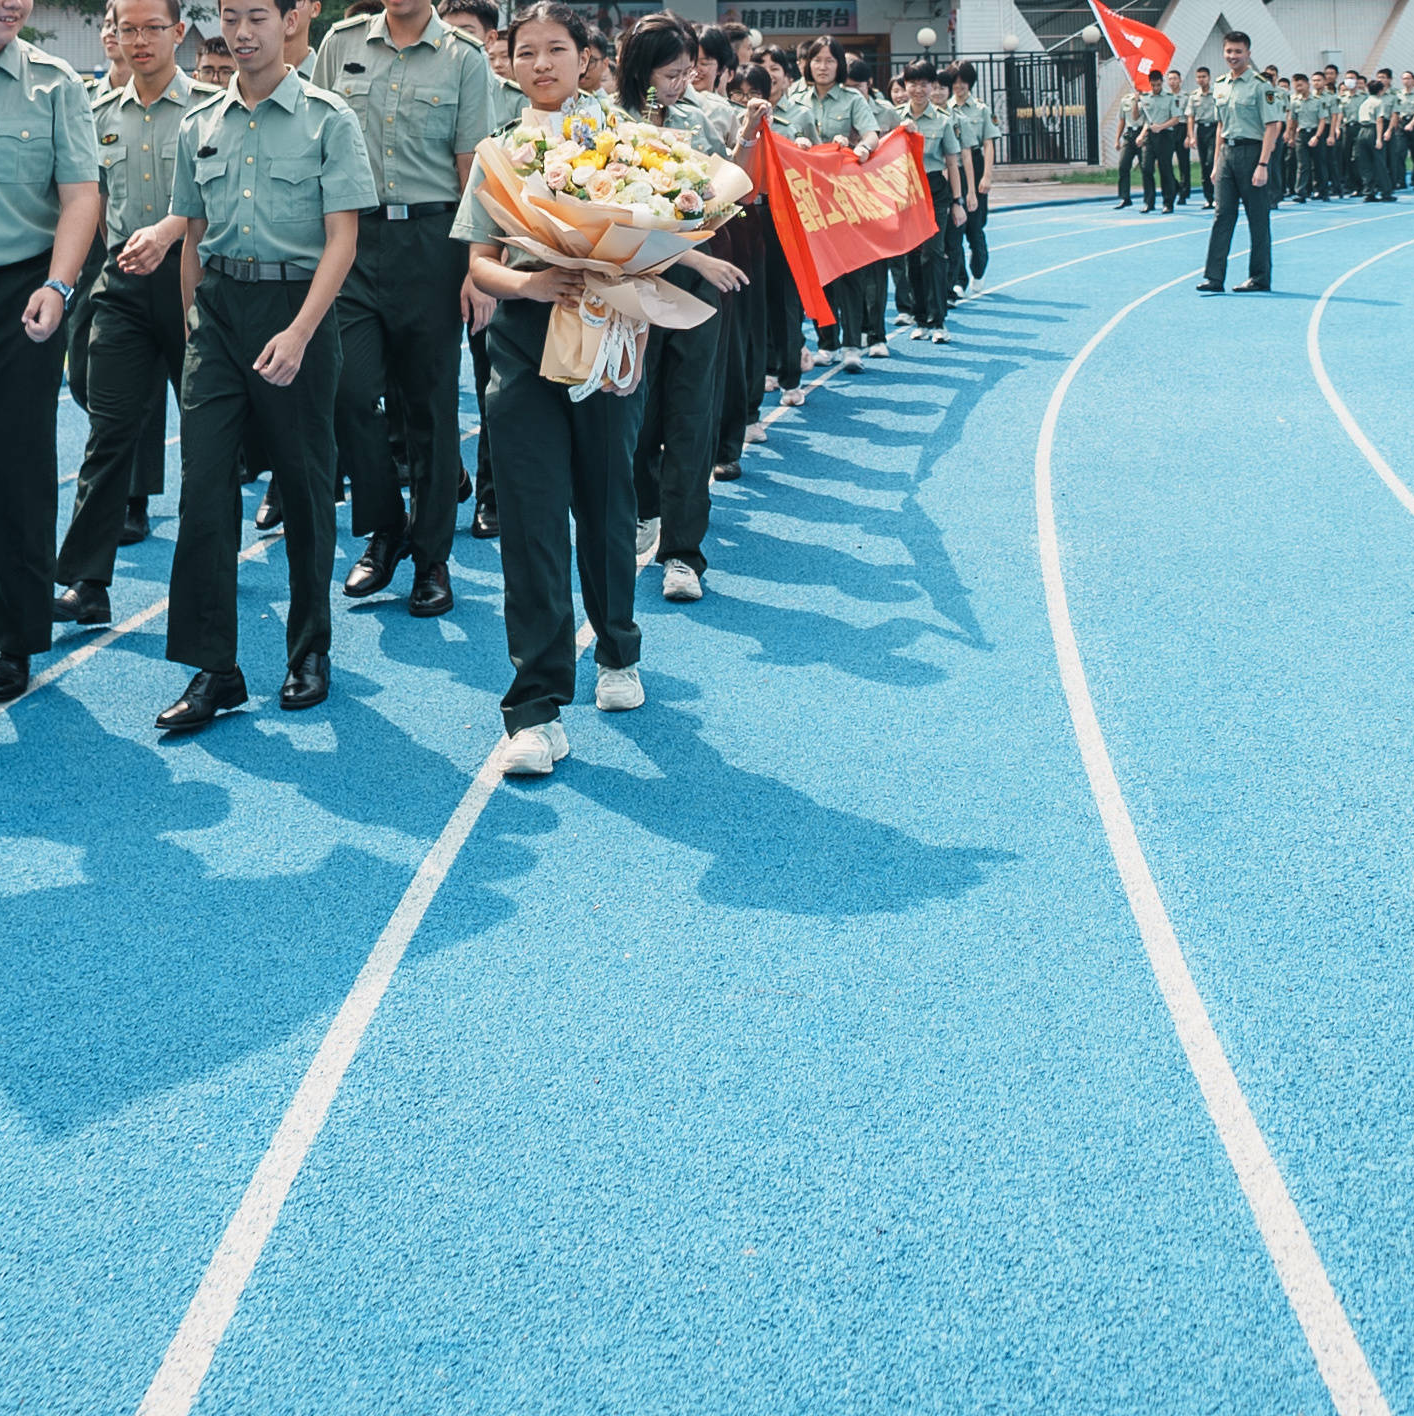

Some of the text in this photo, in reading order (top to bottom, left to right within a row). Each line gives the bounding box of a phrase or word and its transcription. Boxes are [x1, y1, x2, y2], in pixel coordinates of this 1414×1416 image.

[741, 7, 850, 29] 体育馆服务台
